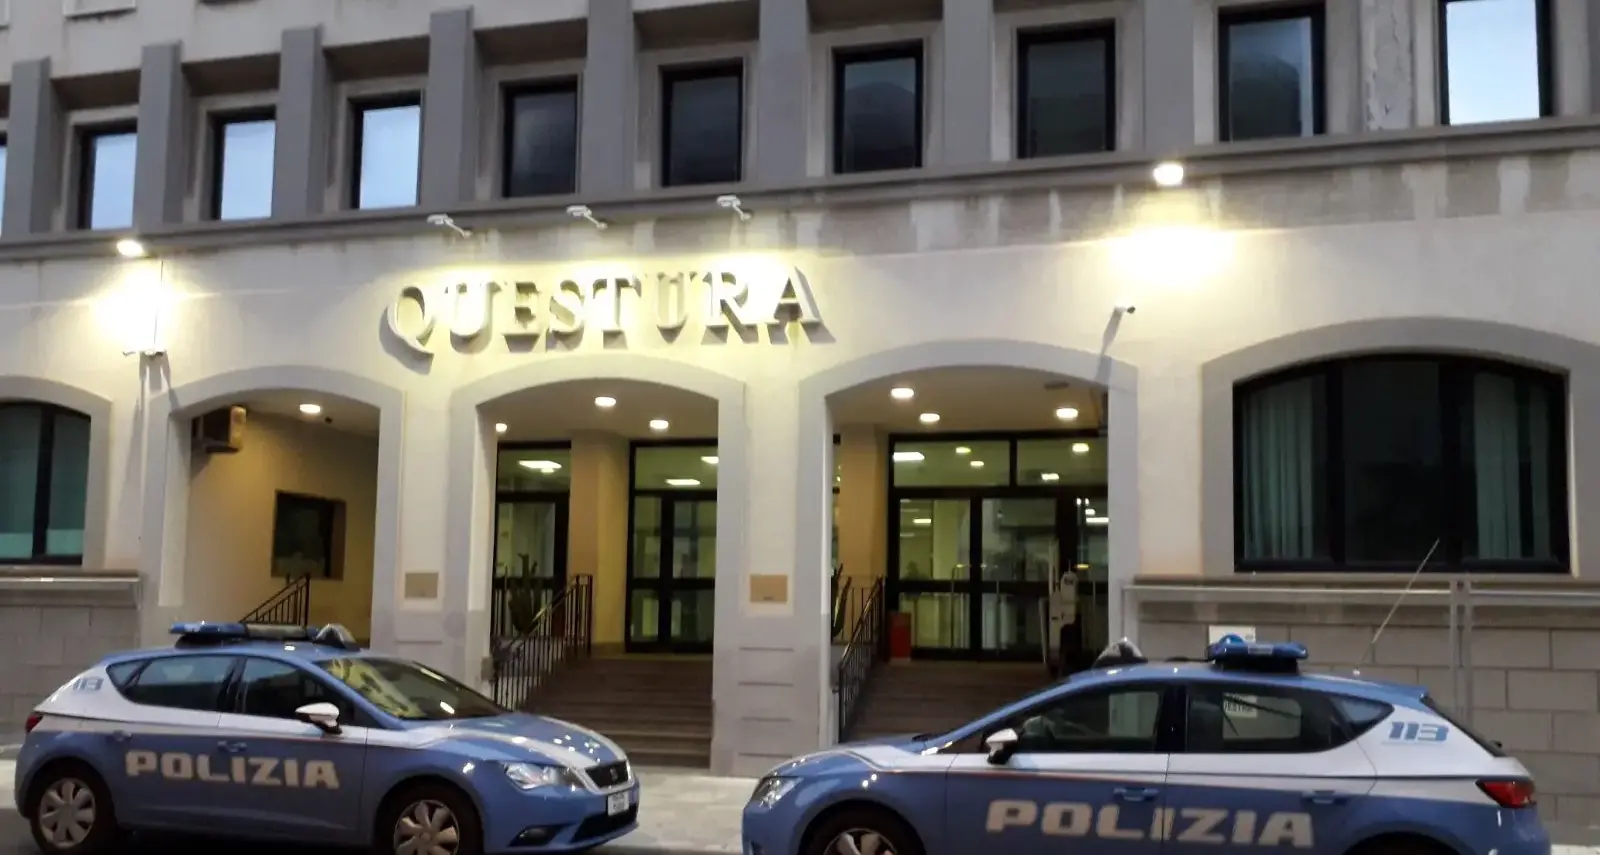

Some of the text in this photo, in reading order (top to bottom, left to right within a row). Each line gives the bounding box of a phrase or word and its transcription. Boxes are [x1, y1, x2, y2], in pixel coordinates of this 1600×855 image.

[382, 264, 826, 366] QUESTURA
[1388, 721, 1449, 743] 113
[125, 750, 340, 789] POLIZIA
[986, 800, 1314, 848] POLIZIA
